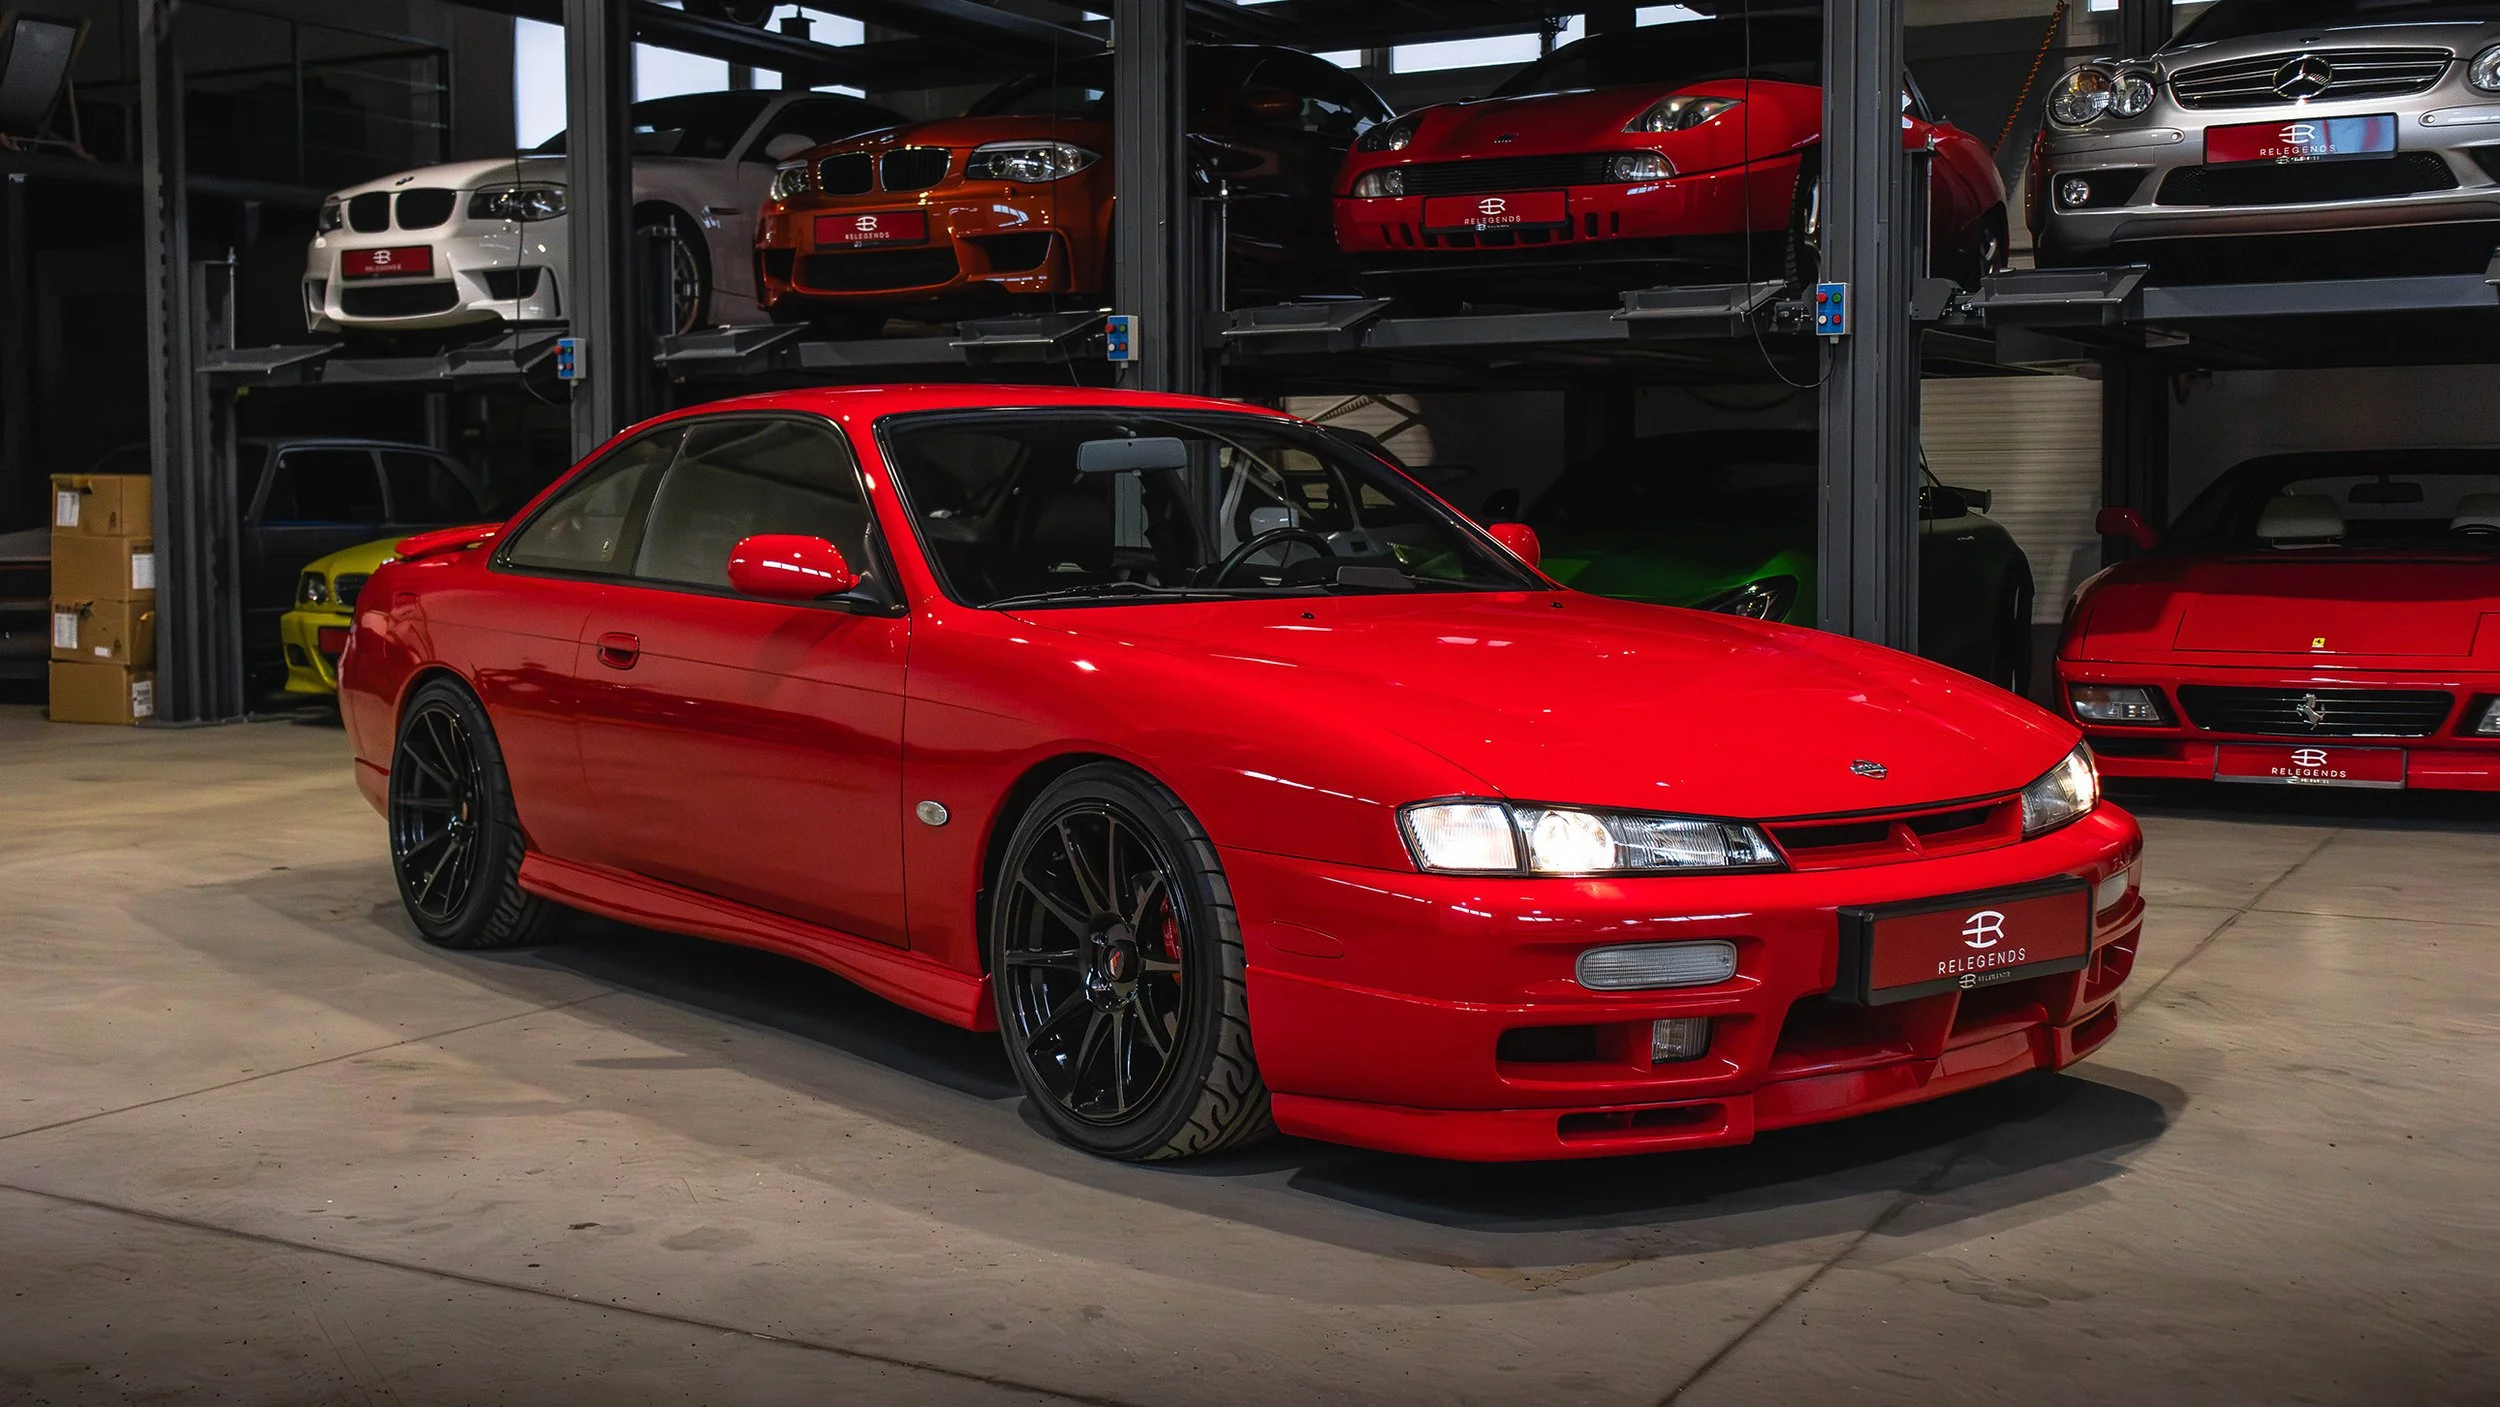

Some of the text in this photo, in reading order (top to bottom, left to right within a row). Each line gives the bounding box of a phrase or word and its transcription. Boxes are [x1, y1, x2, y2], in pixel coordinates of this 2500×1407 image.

[2260, 144, 2336, 156] RELEGENDS
[1464, 215, 1521, 225] RELEGENDS
[2272, 767, 2347, 778] RELEGENDS
[1938, 948, 2026, 974] RELEGENDS
